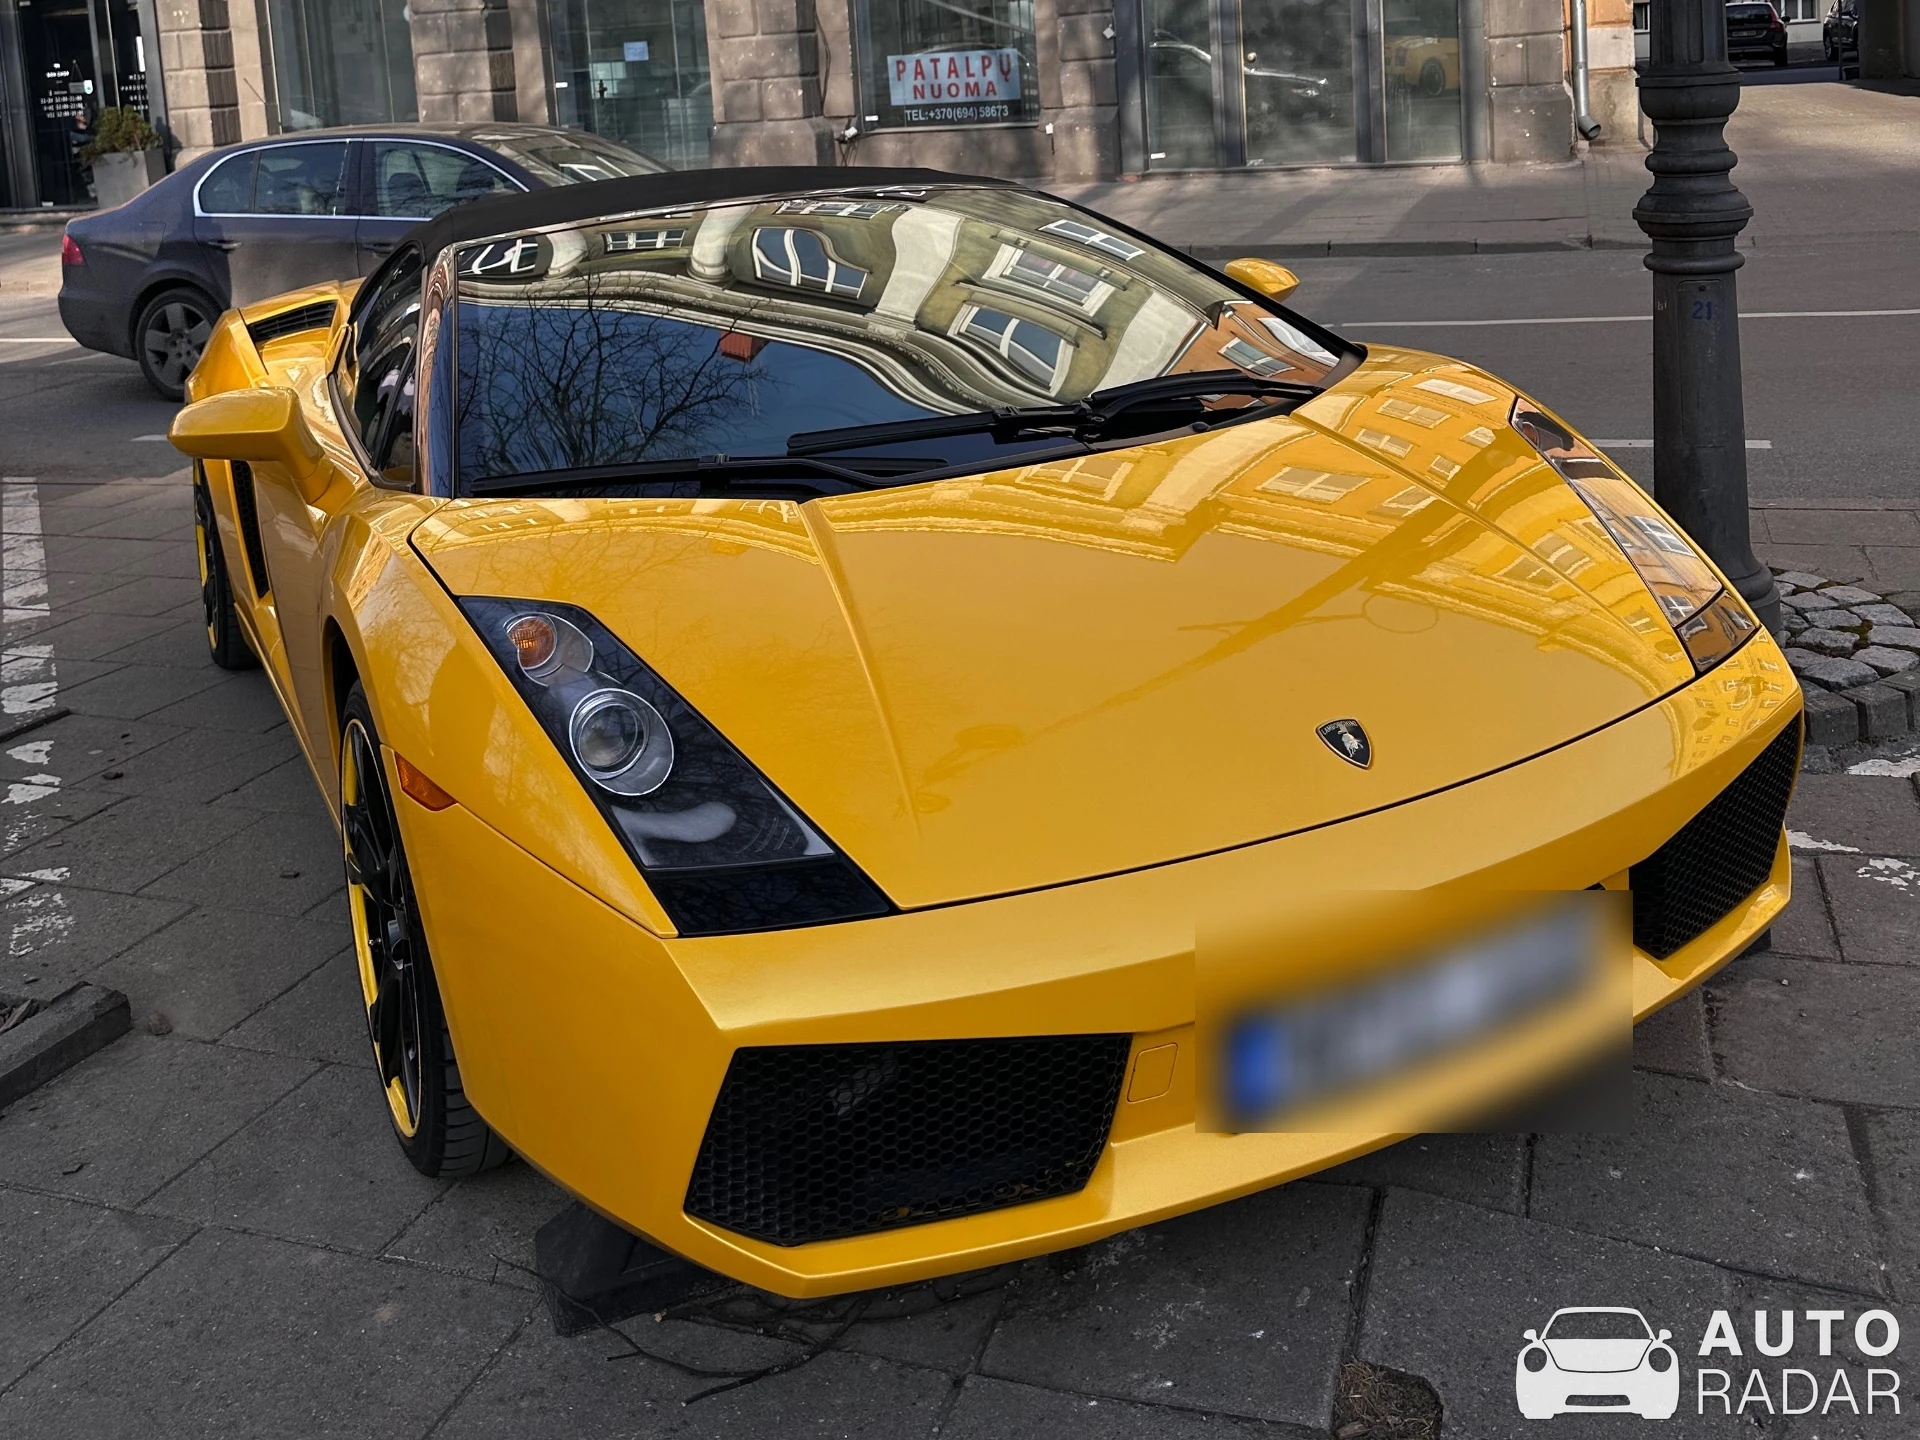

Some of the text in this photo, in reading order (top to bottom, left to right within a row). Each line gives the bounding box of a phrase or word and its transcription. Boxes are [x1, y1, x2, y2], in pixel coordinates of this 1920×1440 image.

[895, 54, 1011, 82] PATALPŲ
[913, 81, 997, 100] NUOMA
[1692, 300, 1712, 320] 21
